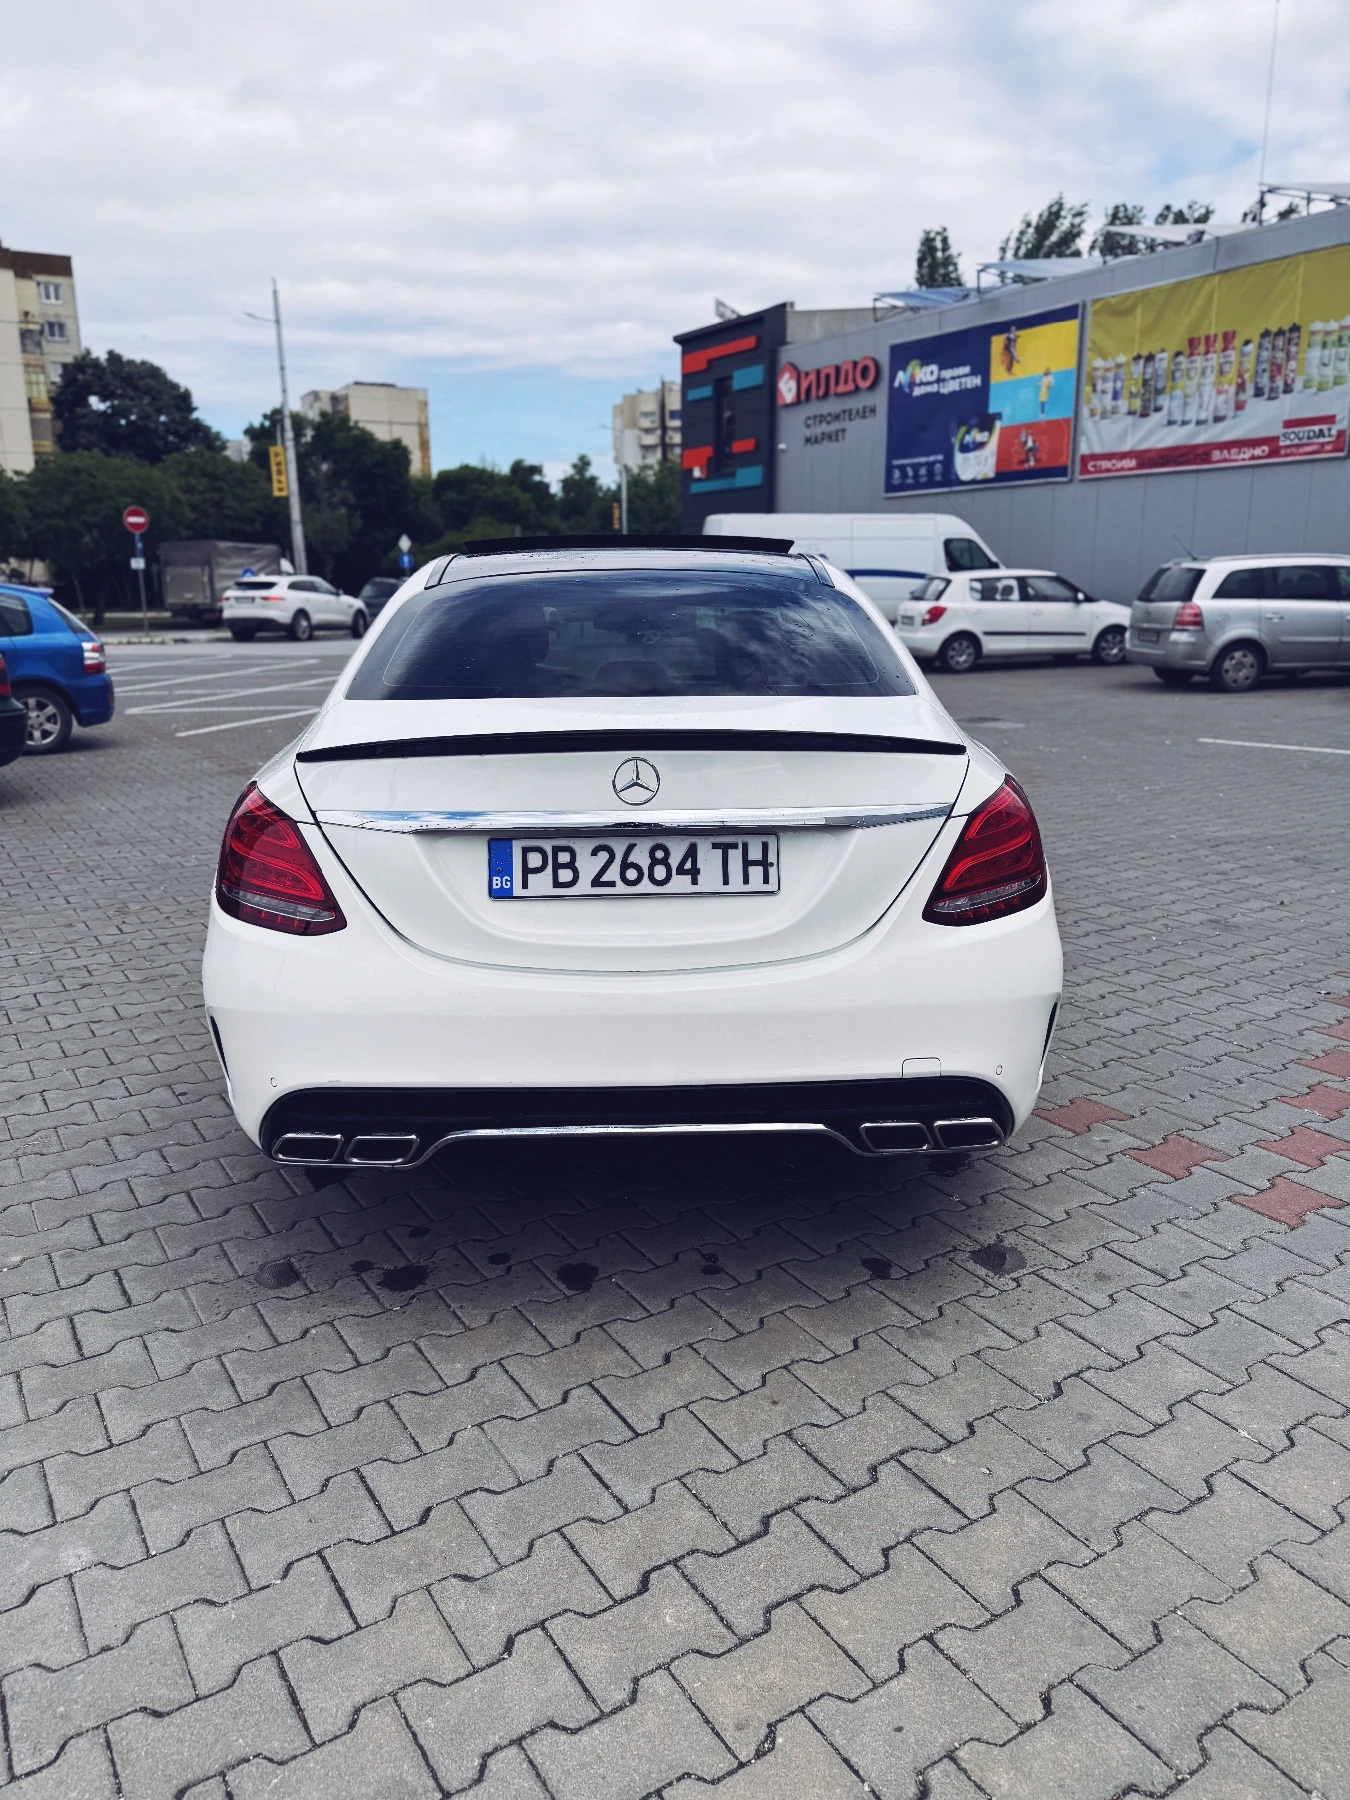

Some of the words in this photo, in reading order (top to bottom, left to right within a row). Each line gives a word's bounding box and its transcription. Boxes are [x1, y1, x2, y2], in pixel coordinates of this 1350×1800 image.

[804, 404, 877, 429] СТРОИТЕЛЕН
[804, 428, 847, 447] МАРКЕТ
[1281, 426, 1335, 443] SOUDAL
[521, 844, 580, 890] PB
[590, 842, 701, 888] 2684
[711, 841, 770, 886] TH
[492, 875, 511, 889] BG
